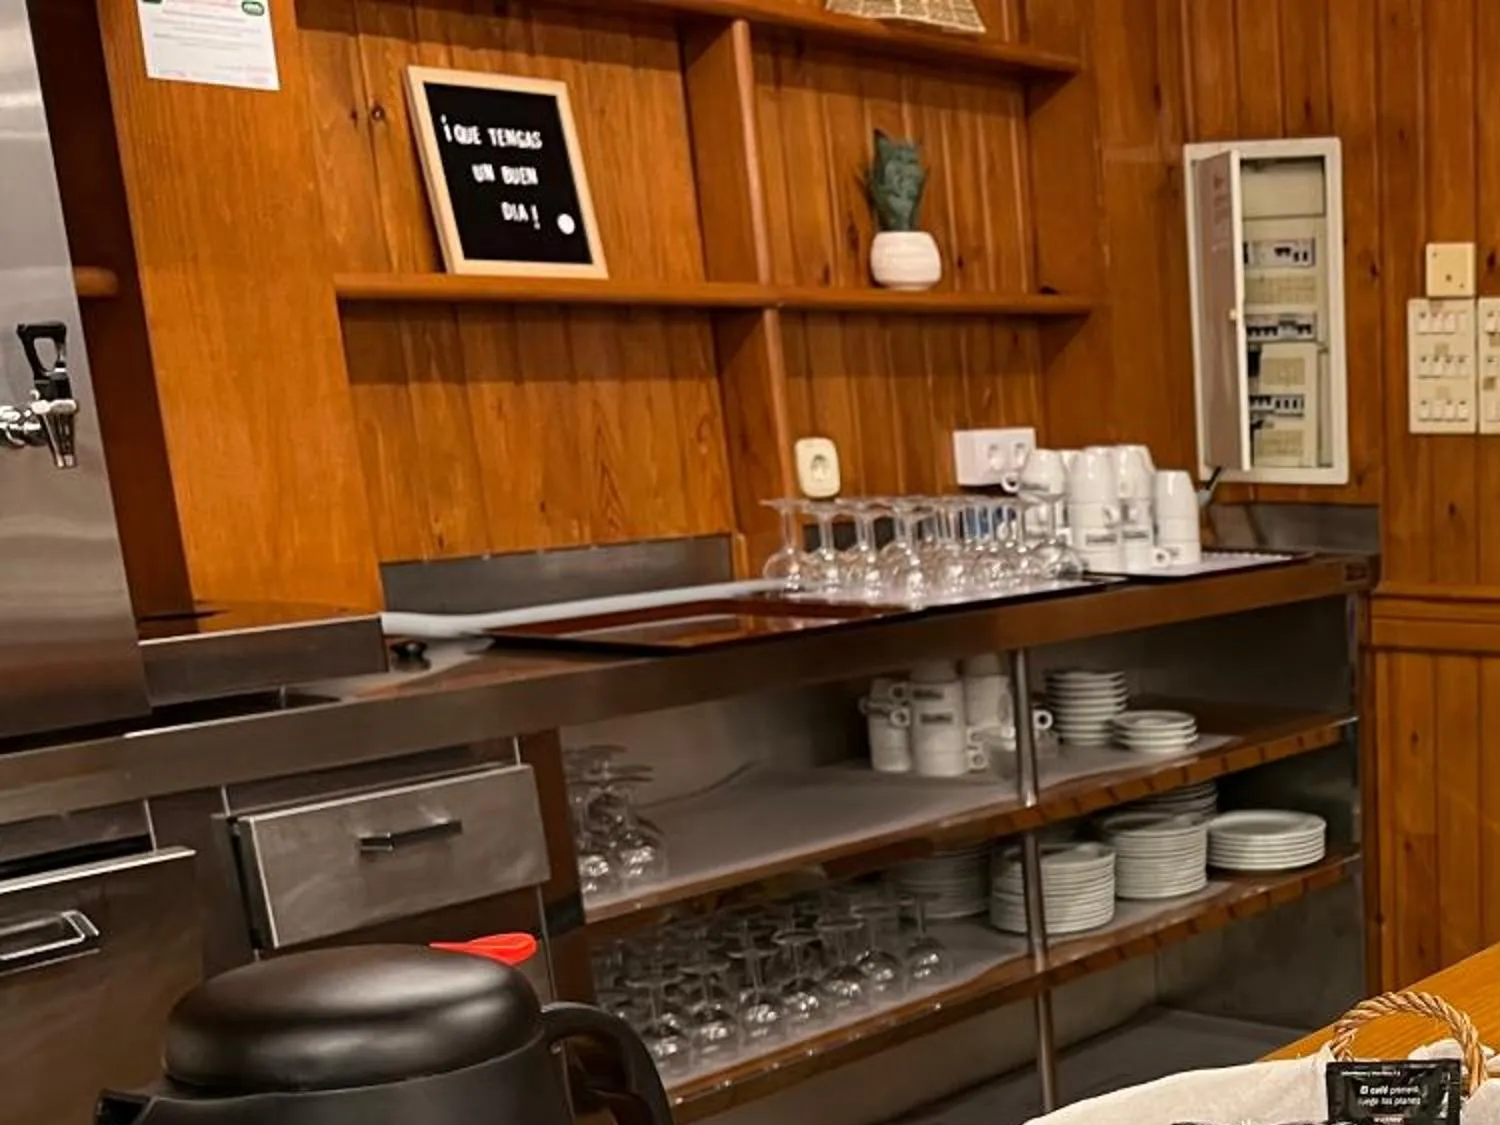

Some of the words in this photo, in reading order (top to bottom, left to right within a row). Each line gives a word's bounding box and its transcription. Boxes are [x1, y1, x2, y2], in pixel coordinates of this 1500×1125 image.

[488, 127, 543, 150] TENGAS
[472, 163, 495, 183] UN
[501, 165, 539, 185] BUEN
